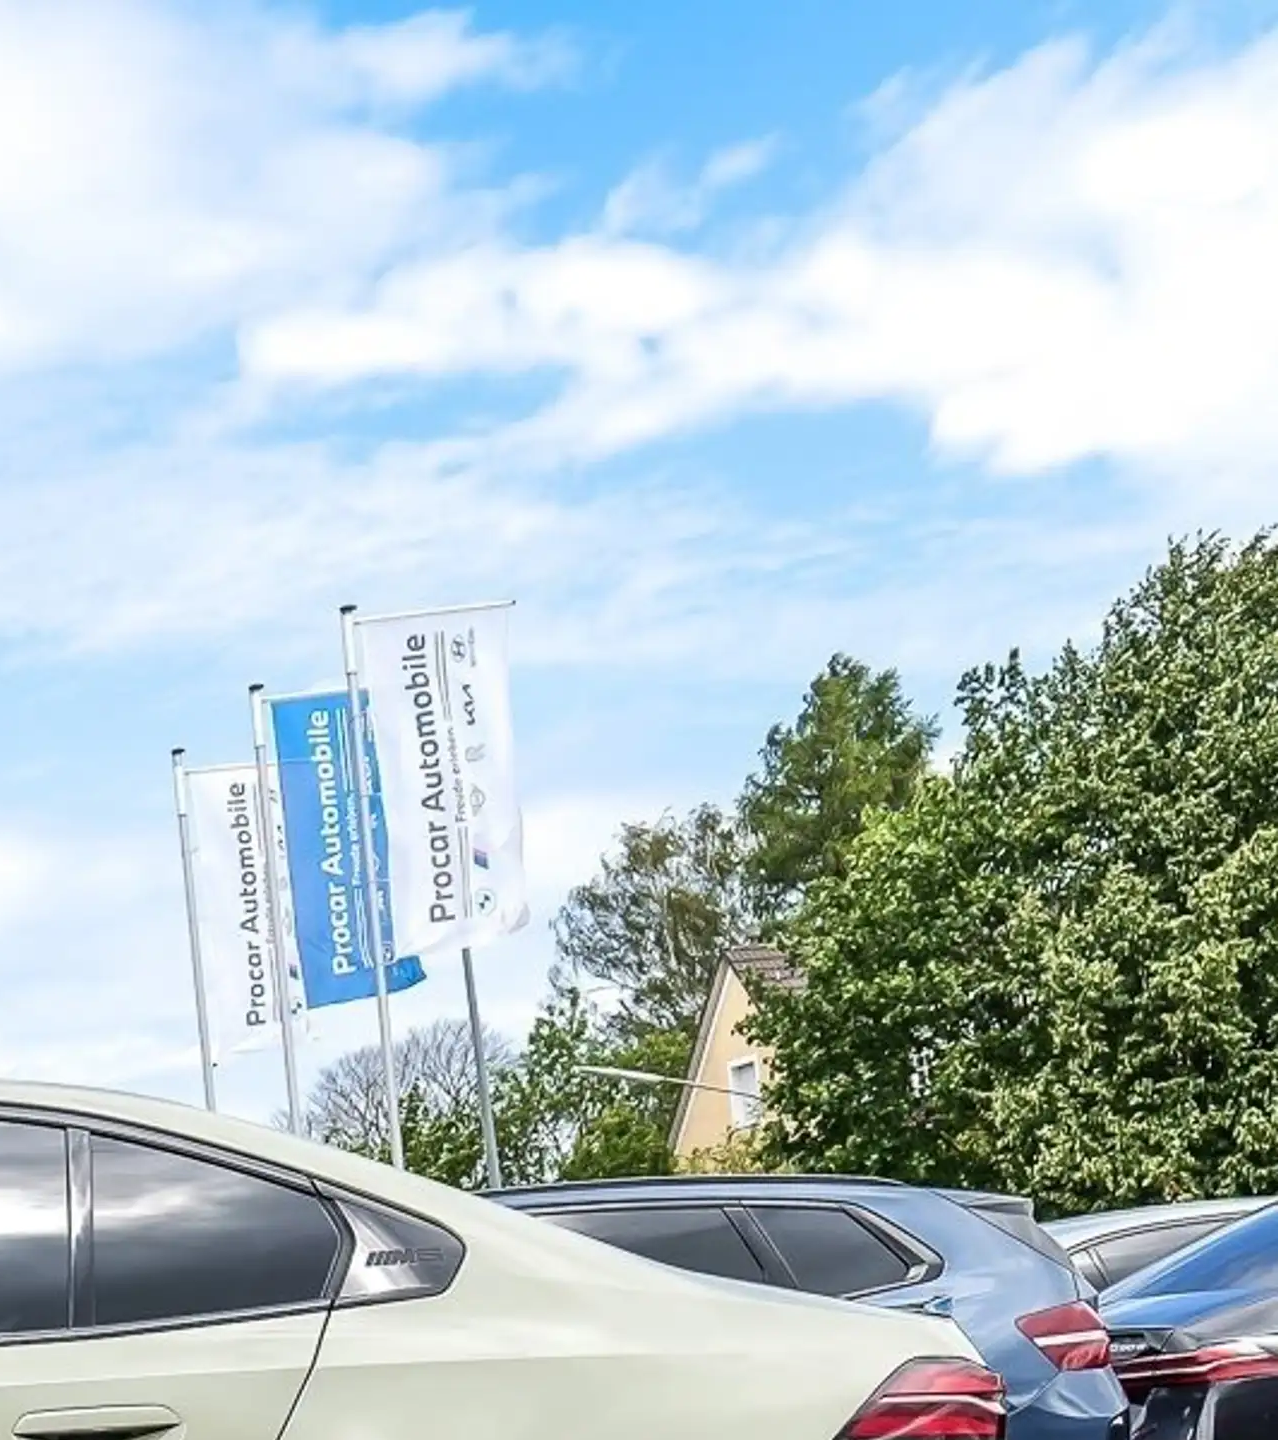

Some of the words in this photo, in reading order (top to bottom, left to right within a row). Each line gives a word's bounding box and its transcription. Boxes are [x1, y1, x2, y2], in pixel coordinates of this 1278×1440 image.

[403, 632, 446, 812] Automobile
[306, 709, 343, 876] Automobile
[227, 783, 259, 934] Automobile
[429, 821, 456, 923] Procar
[242, 939, 267, 1026] Procar
[330, 881, 355, 975] Procar
